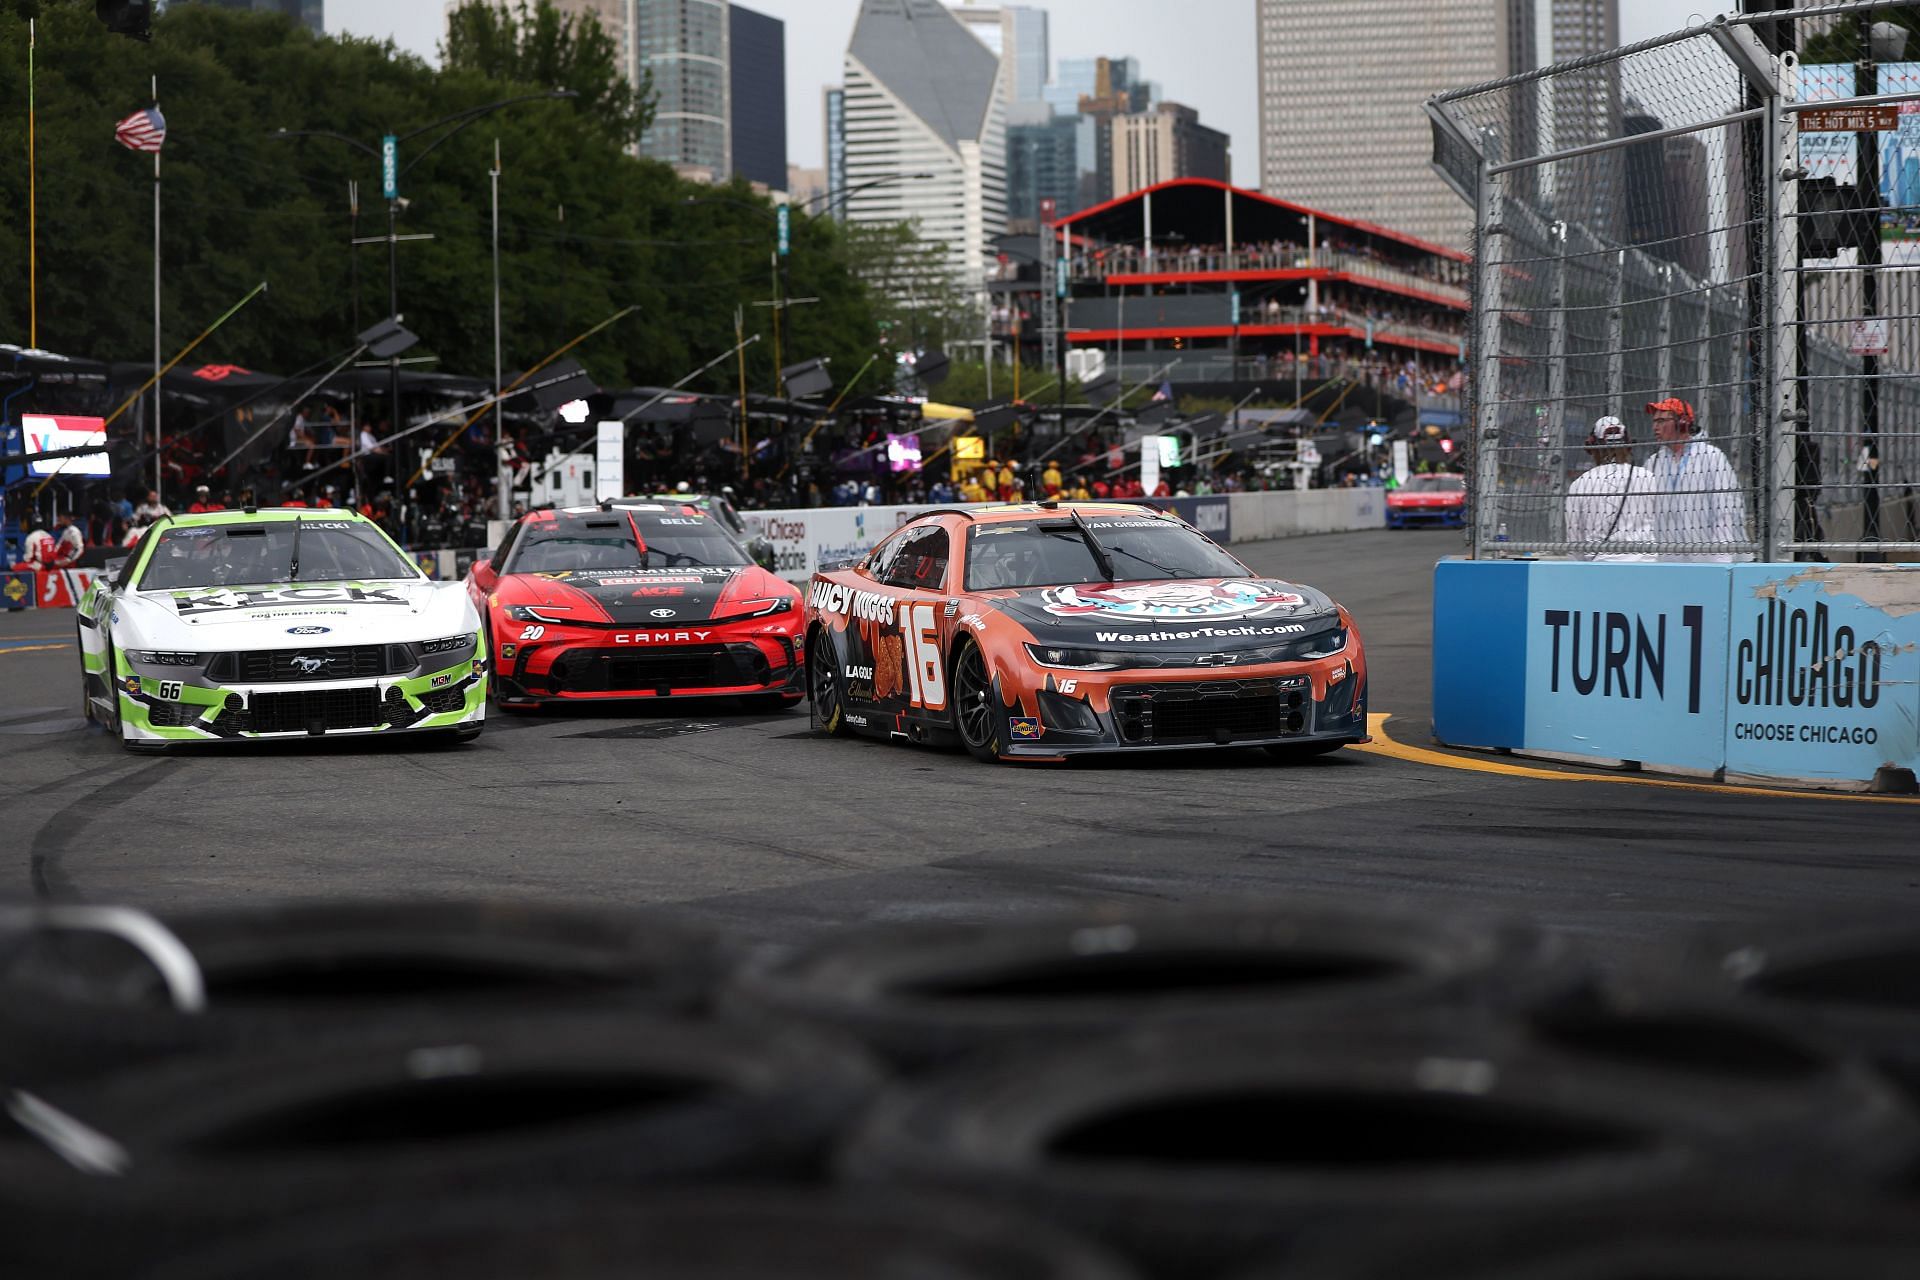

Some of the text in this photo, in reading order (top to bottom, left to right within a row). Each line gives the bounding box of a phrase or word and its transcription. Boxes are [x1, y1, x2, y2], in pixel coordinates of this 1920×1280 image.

[1803, 116, 1893, 130] THE HOT MIX 5 WAY
[659, 518, 703, 526] BELL
[1085, 520, 1182, 529] VAN GISBERGEN
[773, 545, 806, 571] edicine
[43, 573, 58, 602] 5
[170, 583, 408, 610] KICK
[631, 586, 685, 598] ACE
[811, 581, 896, 626] SAUCY NUGGS
[519, 625, 545, 641] 20
[614, 631, 711, 643] CAMRY
[1095, 622, 1305, 643] WeatherTech.com
[900, 605, 945, 705] 16
[1543, 605, 1703, 714] TURN 1
[845, 665, 873, 680] LA GOLF
[160, 682, 181, 700] 66
[1058, 679, 1078, 694] 16
[1734, 722, 1878, 745] CHOOSE CHICAGO
